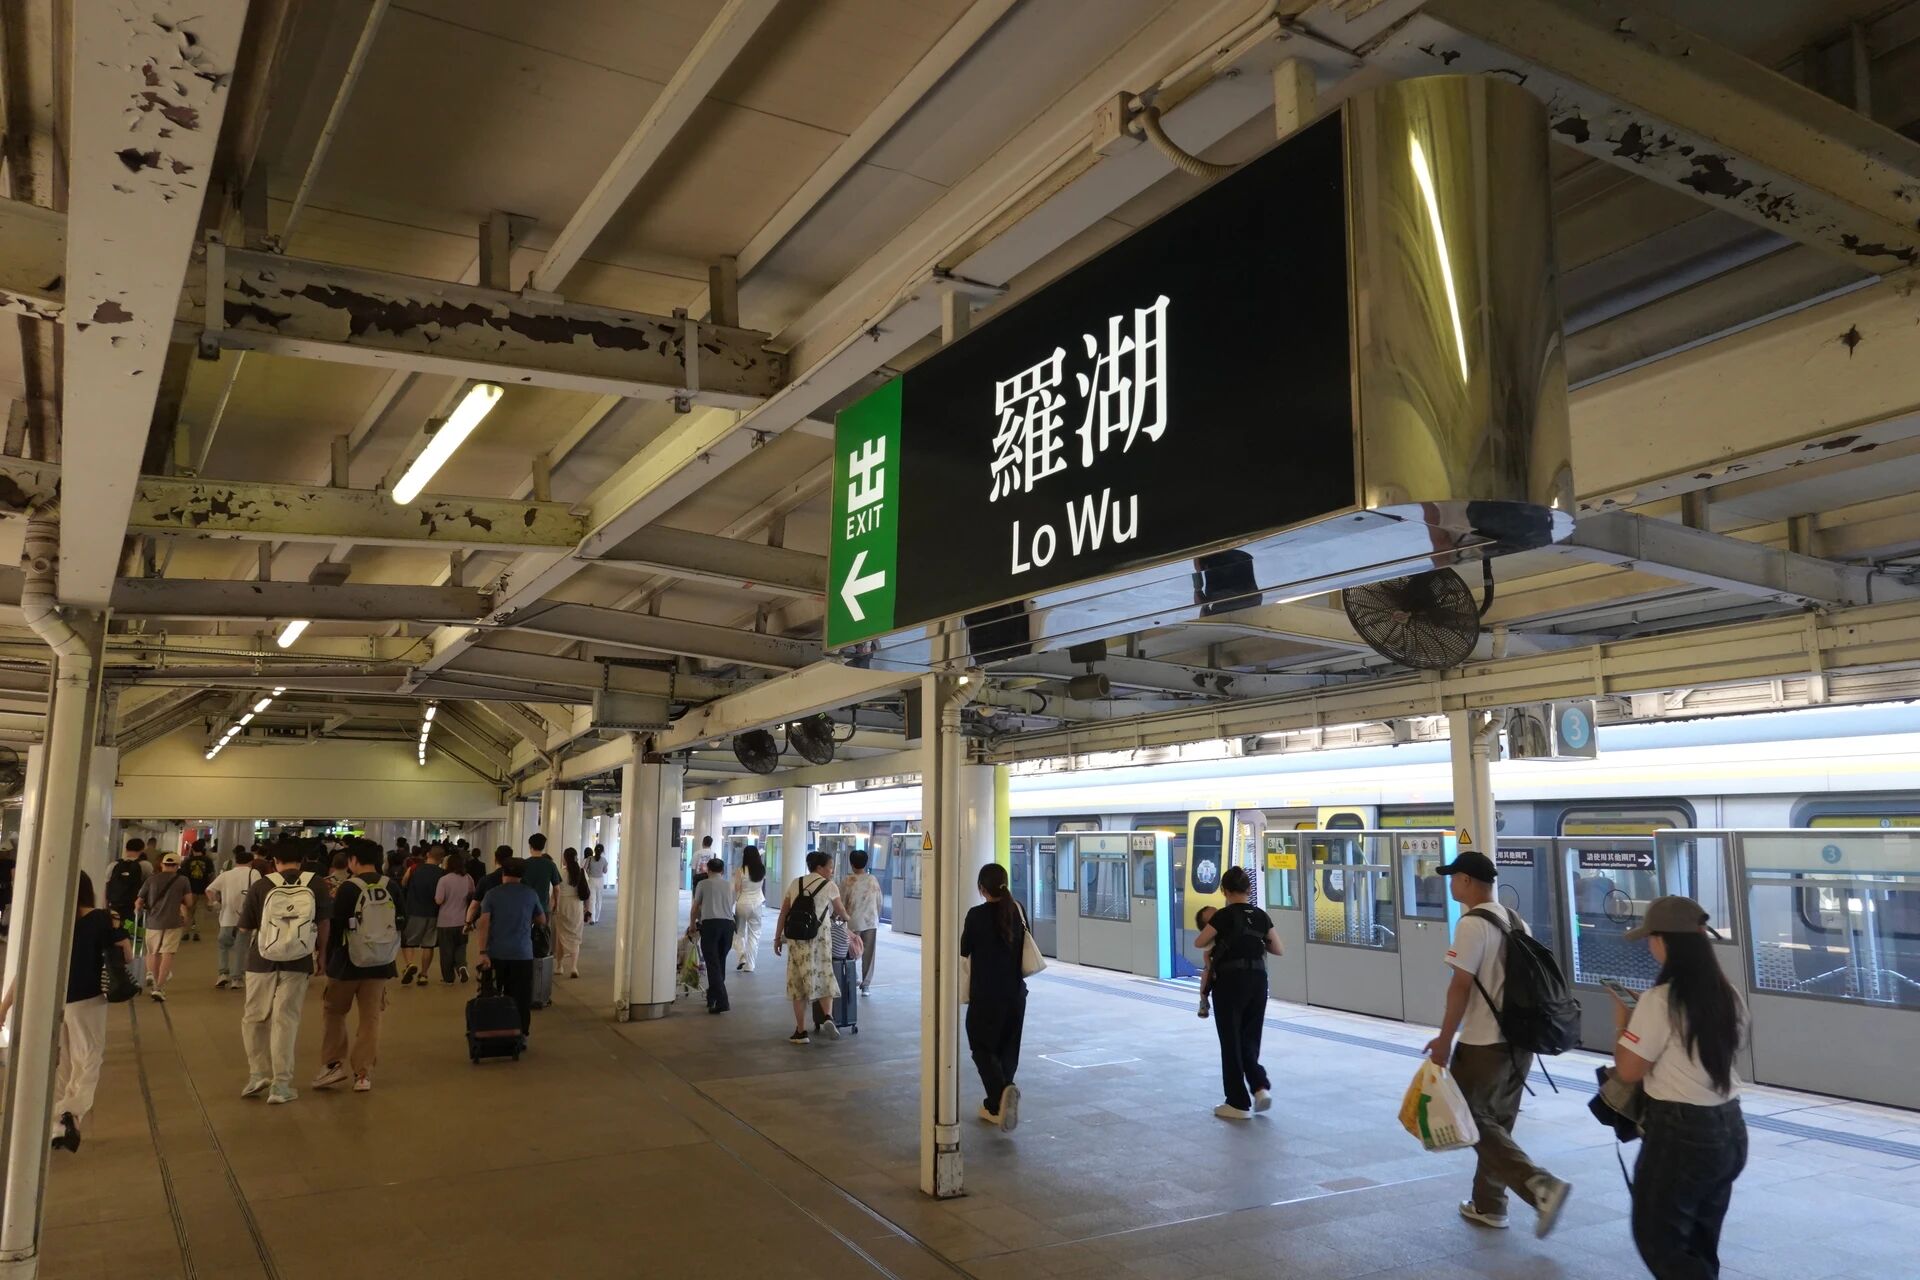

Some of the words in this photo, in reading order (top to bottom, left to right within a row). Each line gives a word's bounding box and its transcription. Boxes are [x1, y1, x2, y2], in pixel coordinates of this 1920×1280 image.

[989, 294, 1171, 503] 羅湖
[847, 435, 886, 514] 出
[846, 503, 884, 541] EXIT
[1011, 520, 1057, 576] Lo
[1066, 487, 1139, 557] Wu
[1569, 715, 1582, 741] 3
[1827, 847, 1836, 861] 3
